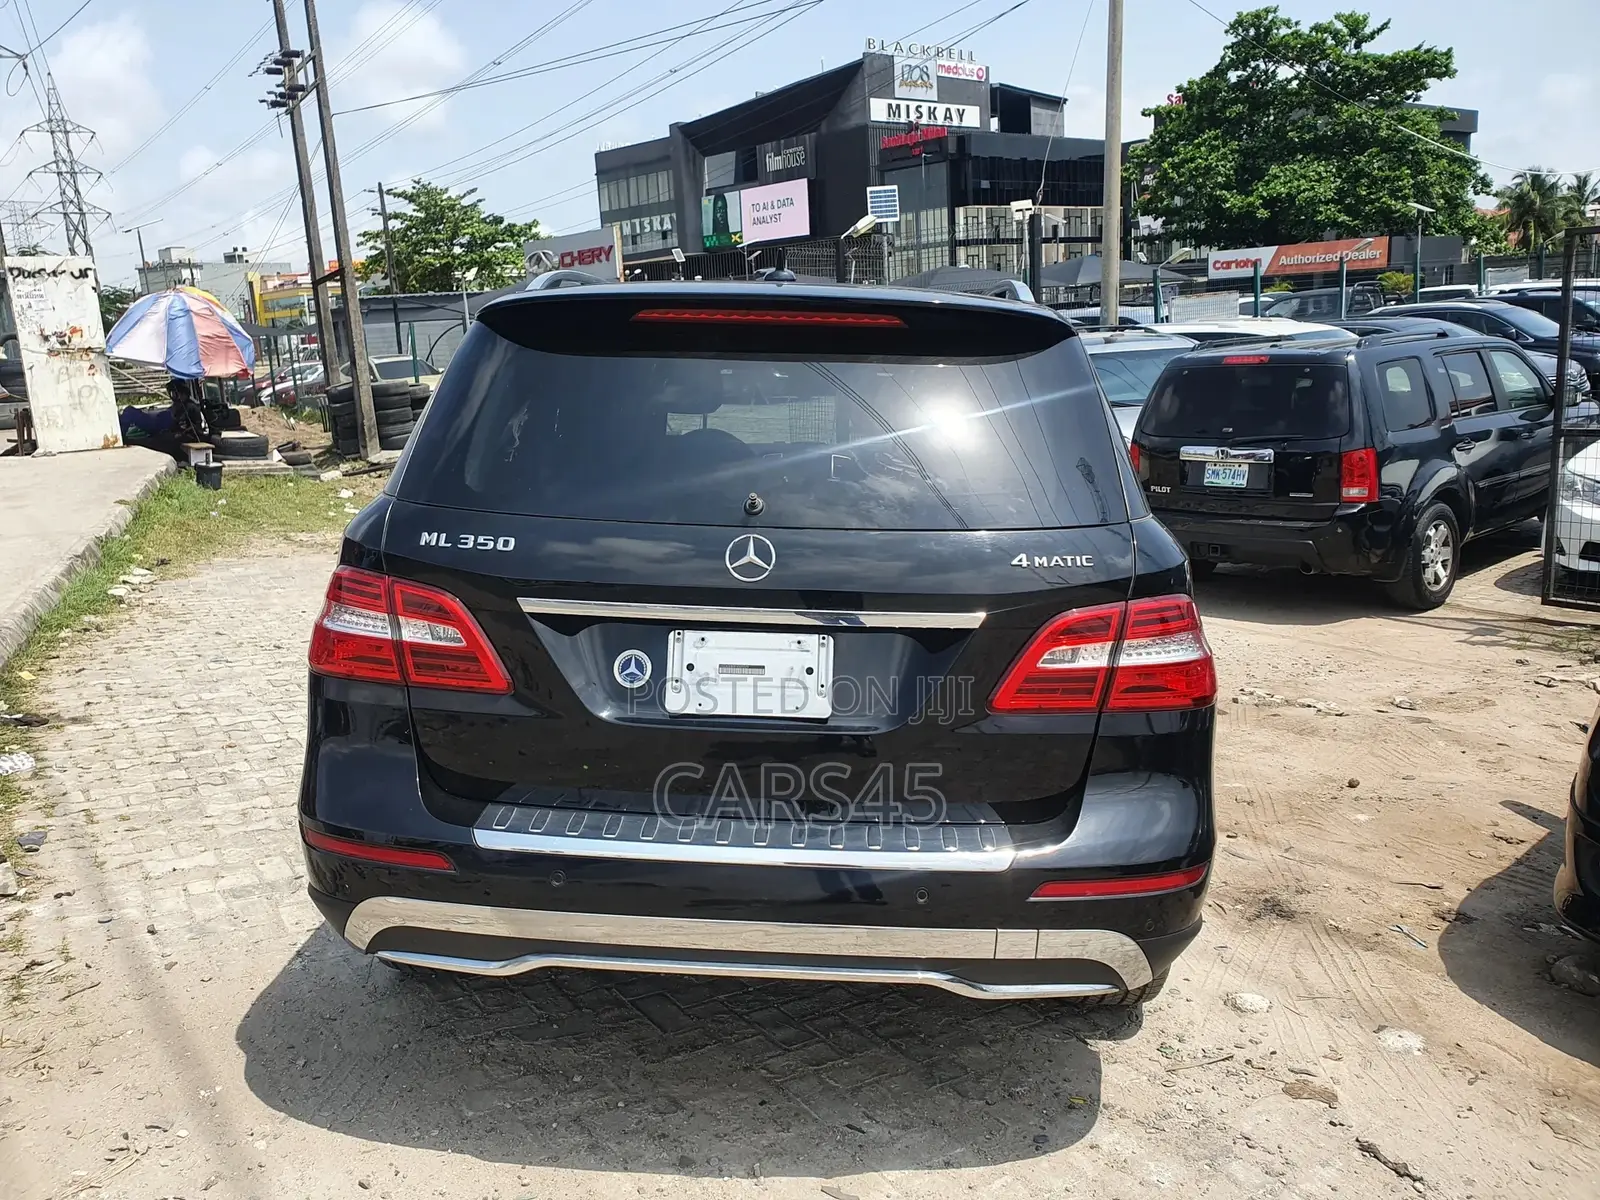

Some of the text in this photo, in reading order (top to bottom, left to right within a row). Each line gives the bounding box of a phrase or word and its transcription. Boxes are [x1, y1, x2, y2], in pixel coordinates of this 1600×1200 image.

[867, 37, 976, 62] BLACKBELL
[937, 63, 975, 78] medplus
[887, 103, 966, 122] MISKAY
[766, 150, 806, 173] filmhouse
[751, 202, 761, 213] TO
[770, 200, 775, 210] &
[777, 197, 795, 209] DATA
[752, 213, 782, 226] ANALYST
[560, 245, 614, 268] CHERY
[1278, 251, 1340, 266] Authorized
[1343, 249, 1382, 262] Dealer
[419, 532, 516, 551] ML 350
